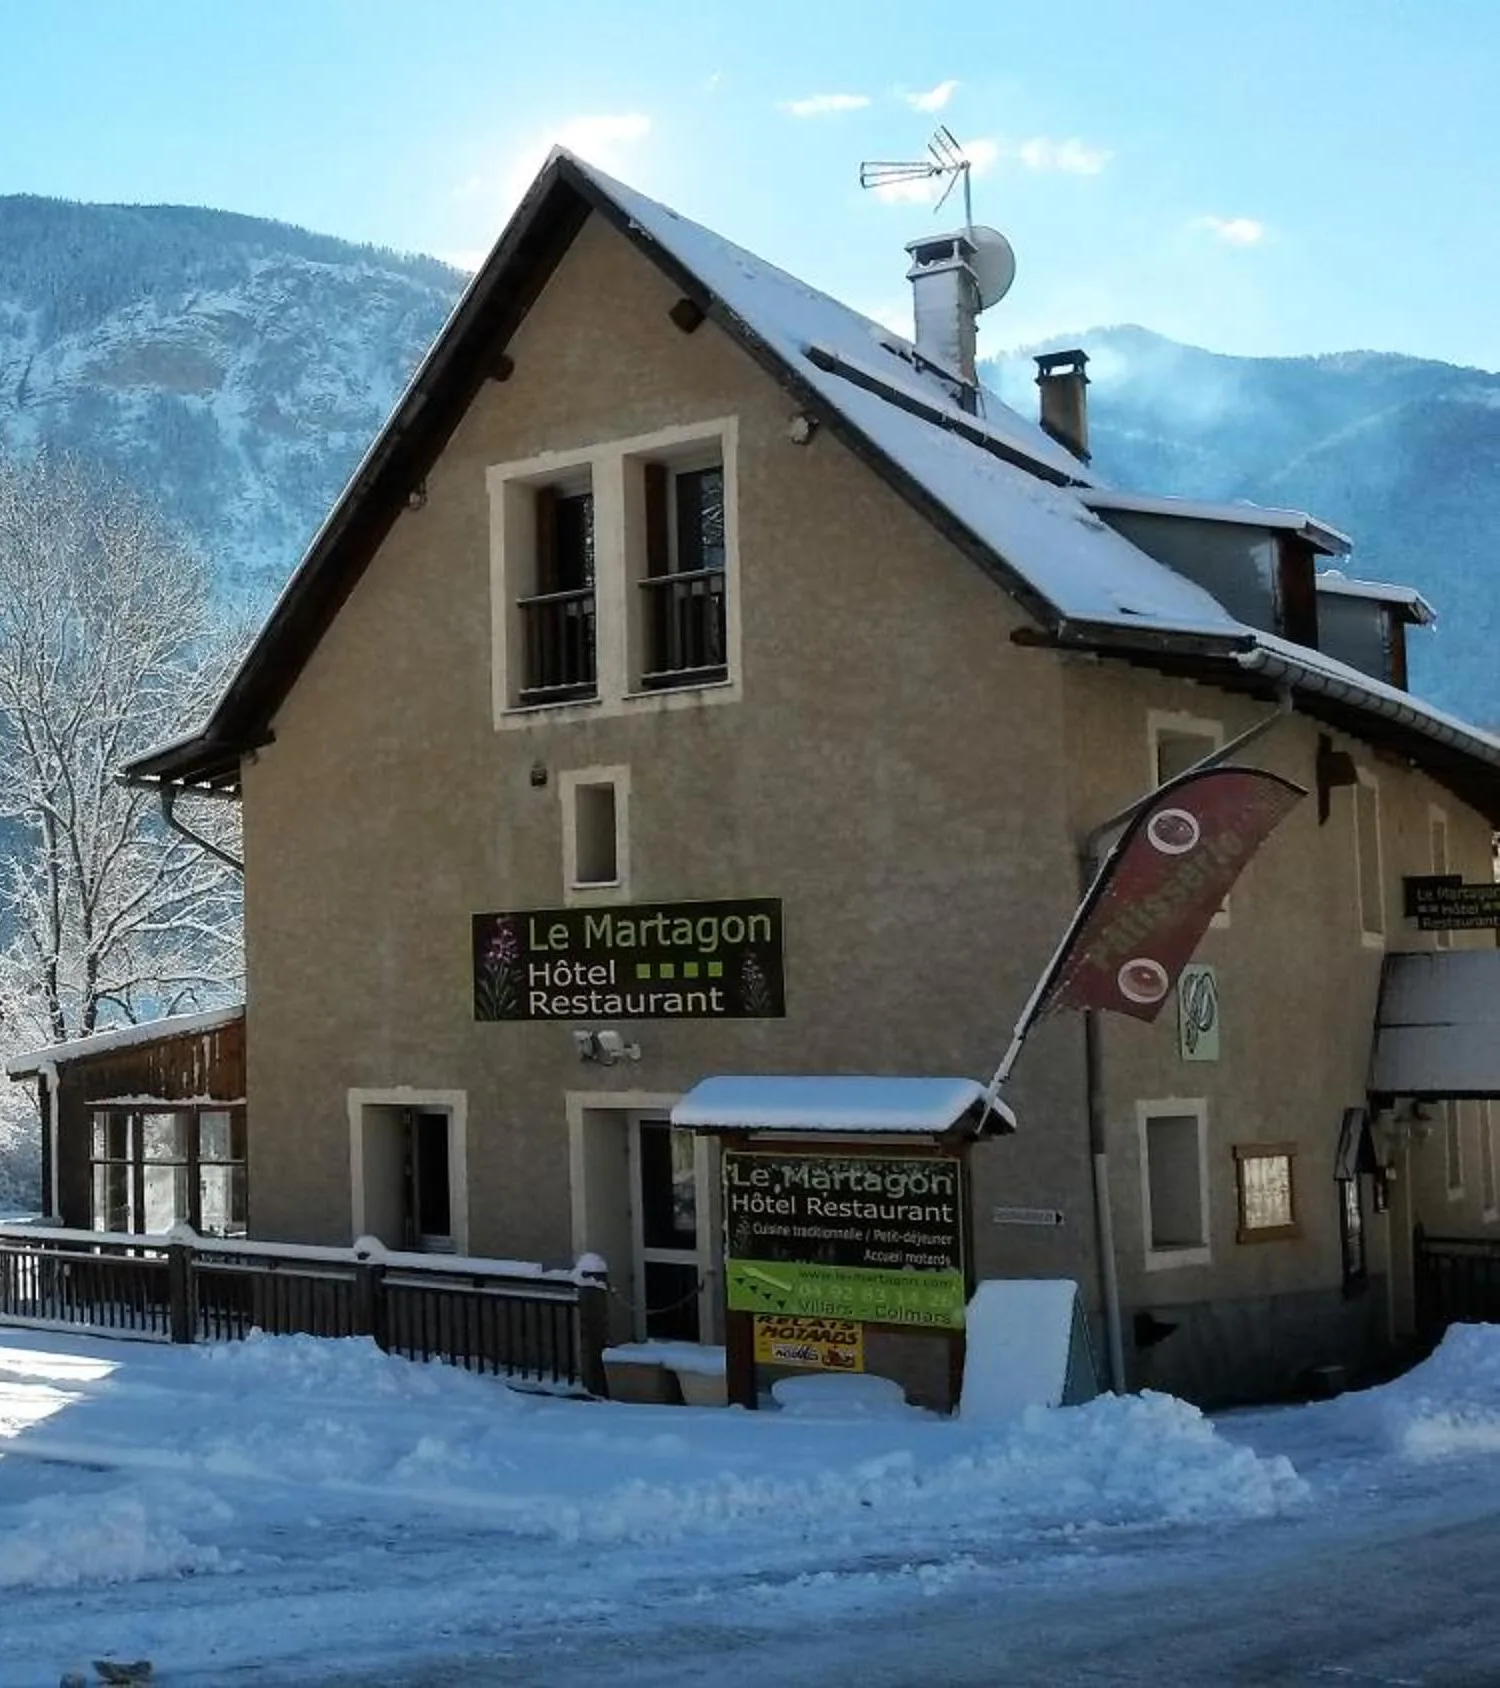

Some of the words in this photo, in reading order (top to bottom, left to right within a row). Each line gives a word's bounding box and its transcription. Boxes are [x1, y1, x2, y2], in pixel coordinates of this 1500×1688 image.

[528, 917, 569, 951] Le
[585, 911, 771, 953] Martagon
[528, 959, 616, 987] Hôtel
[529, 987, 725, 1015] Restaurant
[732, 1163, 770, 1187] Le
[780, 1164, 953, 1199] Martagon
[731, 1191, 796, 1215] Hôtel
[806, 1196, 953, 1223] Restaurant
[752, 1222, 790, 1236] Cuisine
[863, 1248, 903, 1263] Accueil
[801, 1299, 854, 1315] Villars
[875, 1304, 951, 1324] Colmars
[760, 1325, 858, 1345] MOTARDS
